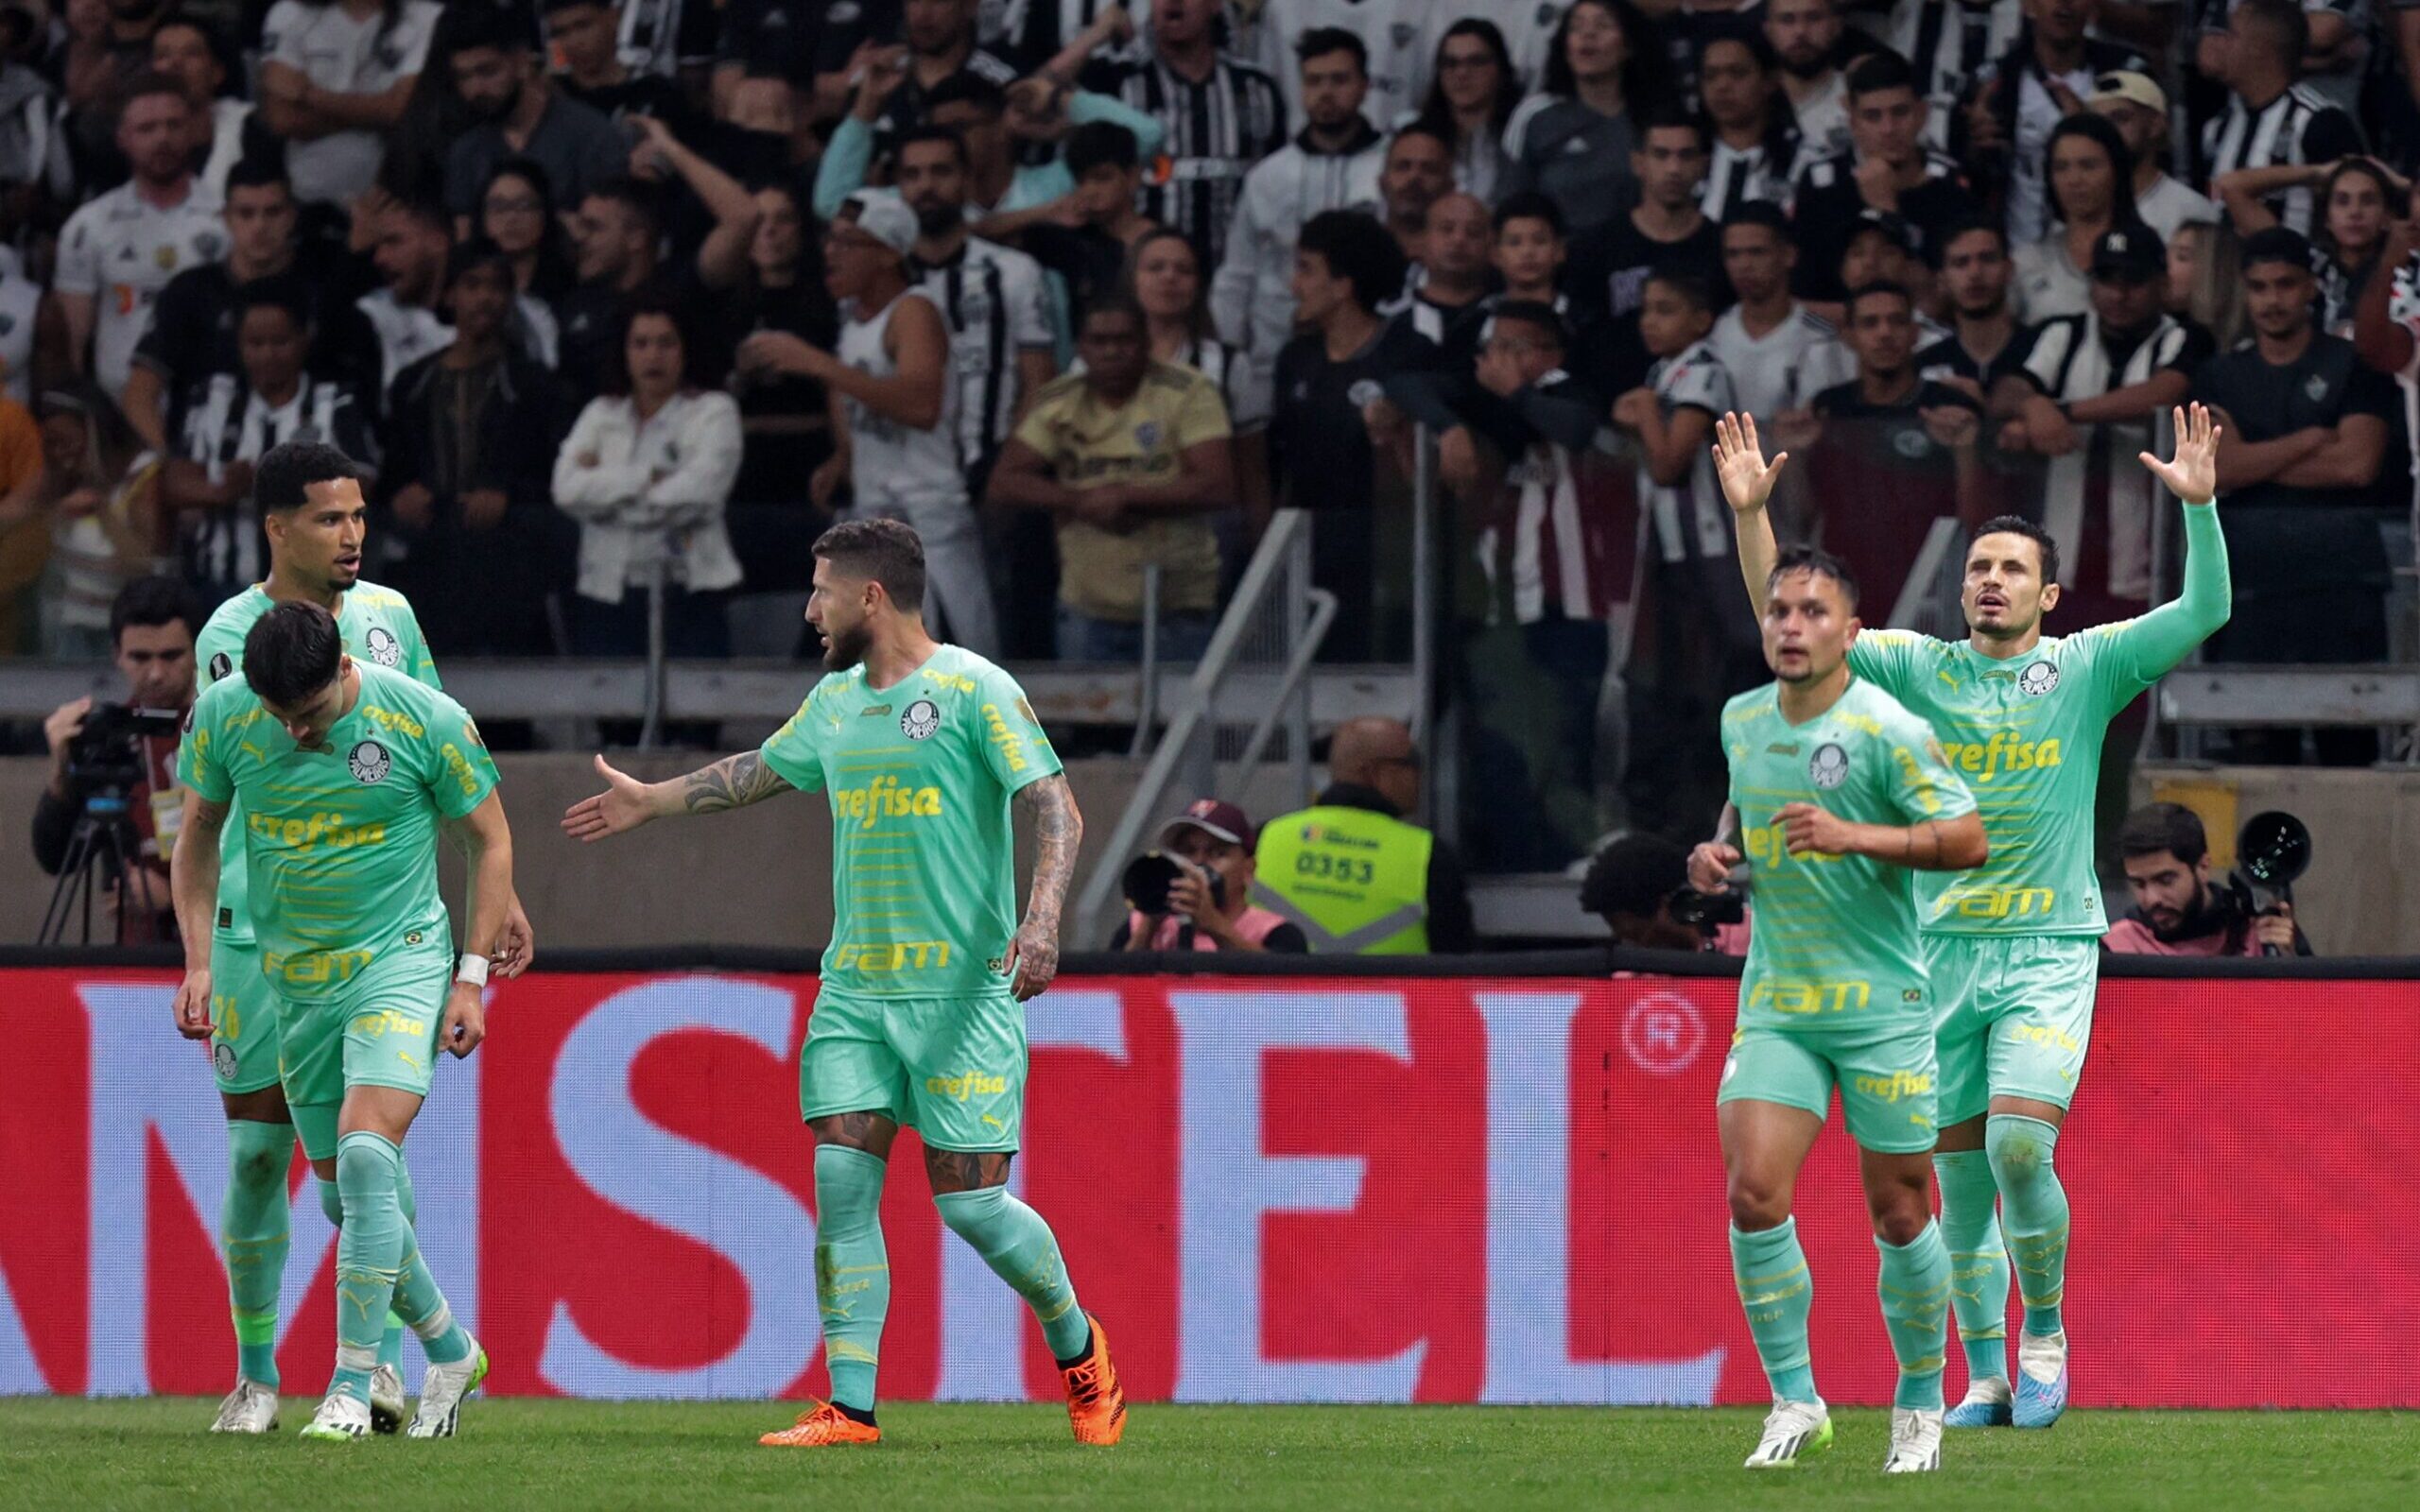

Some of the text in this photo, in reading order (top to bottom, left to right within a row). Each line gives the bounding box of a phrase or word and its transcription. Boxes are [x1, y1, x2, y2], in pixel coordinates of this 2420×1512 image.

[363, 705, 424, 739] crefisa
[1942, 731, 2062, 783] refisa
[836, 774, 942, 830] refisa
[250, 812, 386, 851] crefisa
[925, 1070, 1006, 1103] crefisa
[0, 975, 1725, 1406] MSTEL
